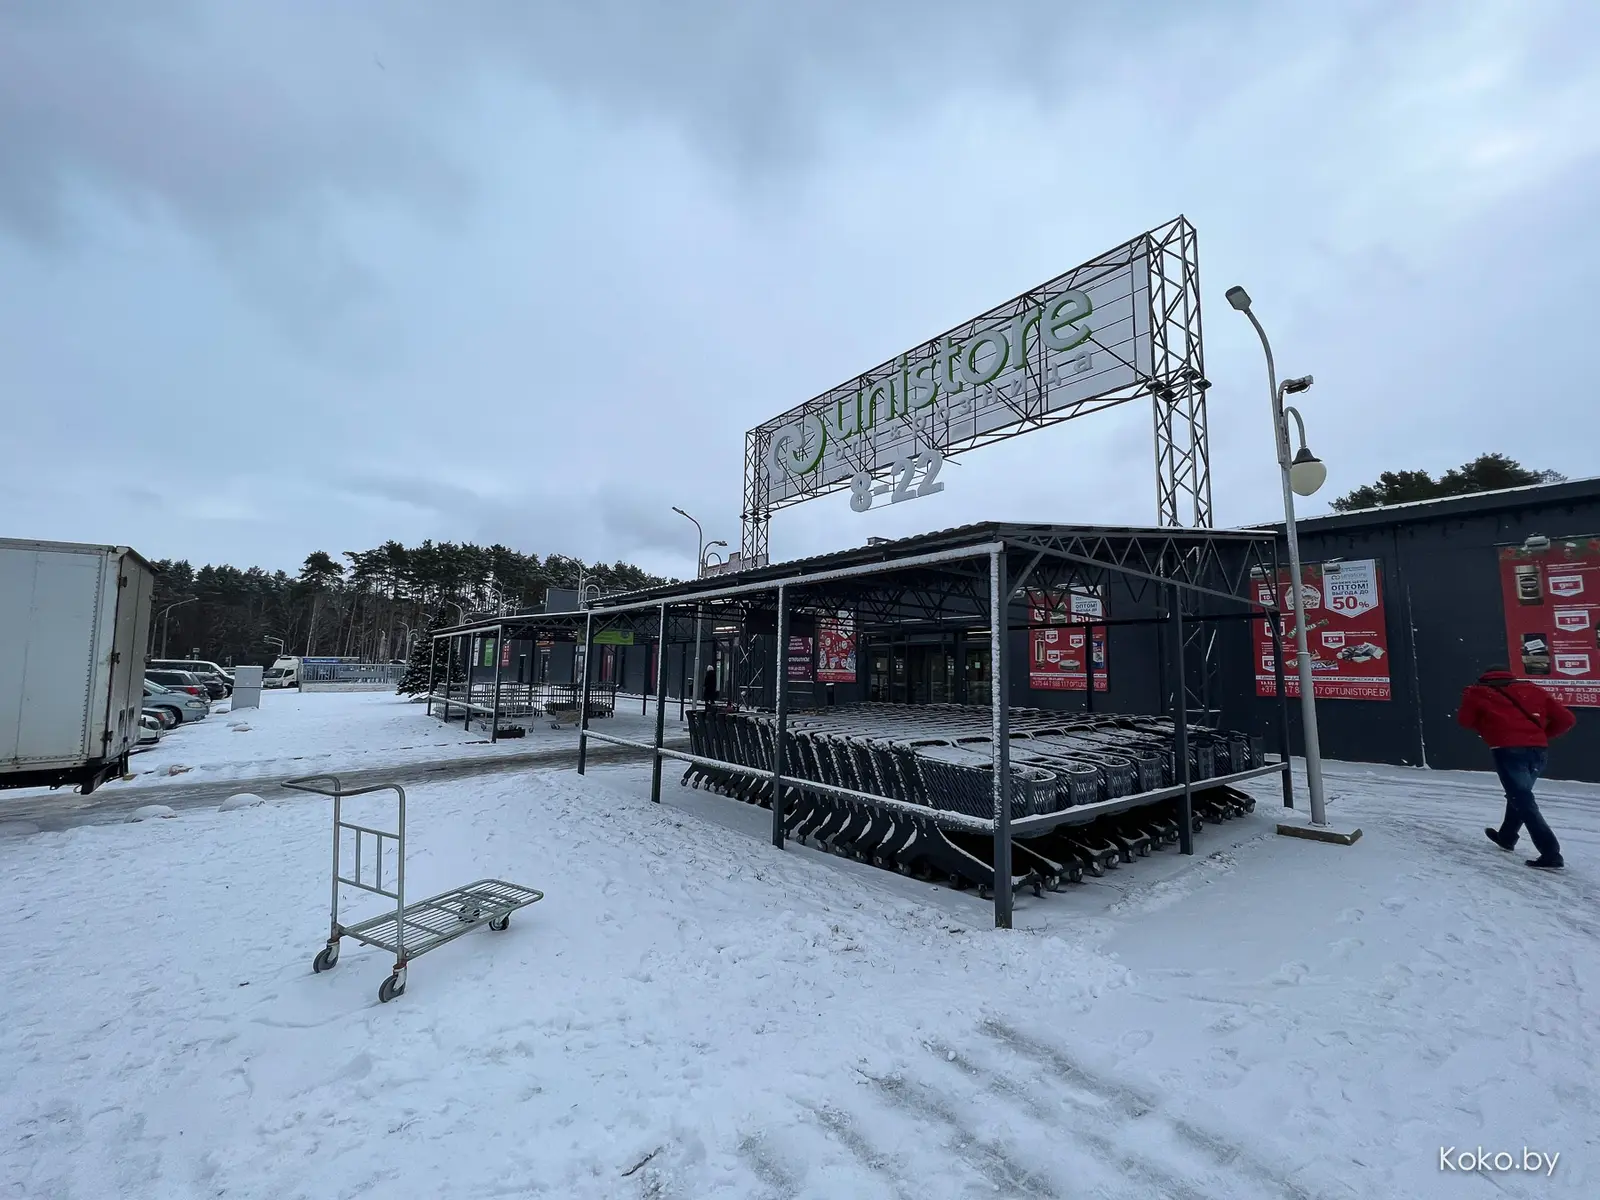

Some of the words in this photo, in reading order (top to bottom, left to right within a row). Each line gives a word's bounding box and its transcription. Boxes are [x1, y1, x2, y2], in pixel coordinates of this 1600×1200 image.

[832, 289, 1094, 440] unistore
[912, 350, 1094, 439] розница
[849, 448, 945, 512] 8-22
[1331, 583, 1369, 591] ОПТОМ!
